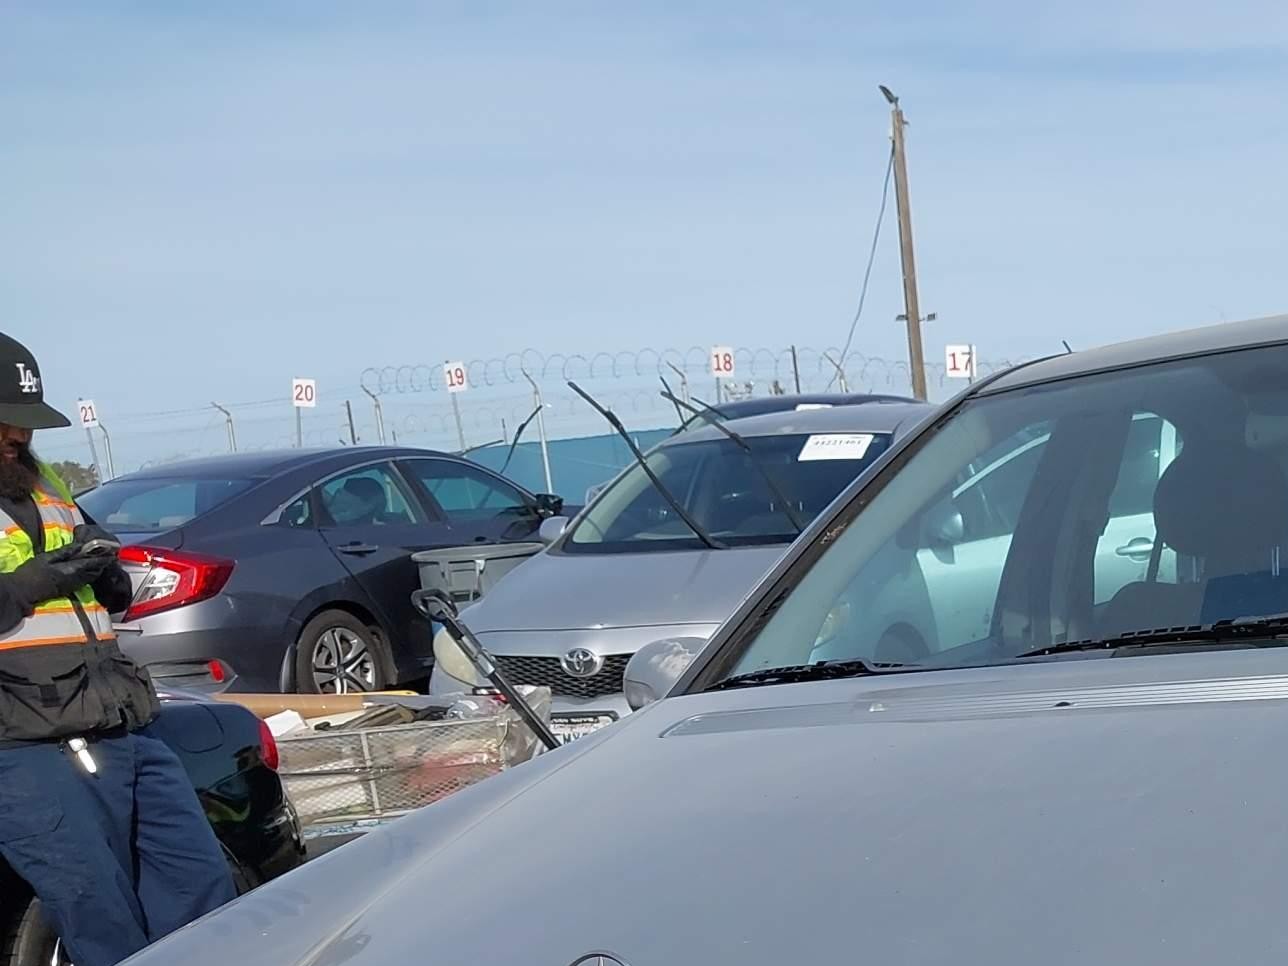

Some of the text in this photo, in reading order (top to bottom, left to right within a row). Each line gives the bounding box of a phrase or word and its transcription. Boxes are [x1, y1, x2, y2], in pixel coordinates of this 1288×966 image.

[713, 352, 733, 372] 18
[948, 352, 973, 372] 17
[16, 363, 39, 393] LA
[447, 367, 465, 387] 19
[294, 385, 314, 402] 20
[80, 405, 97, 423] 21
